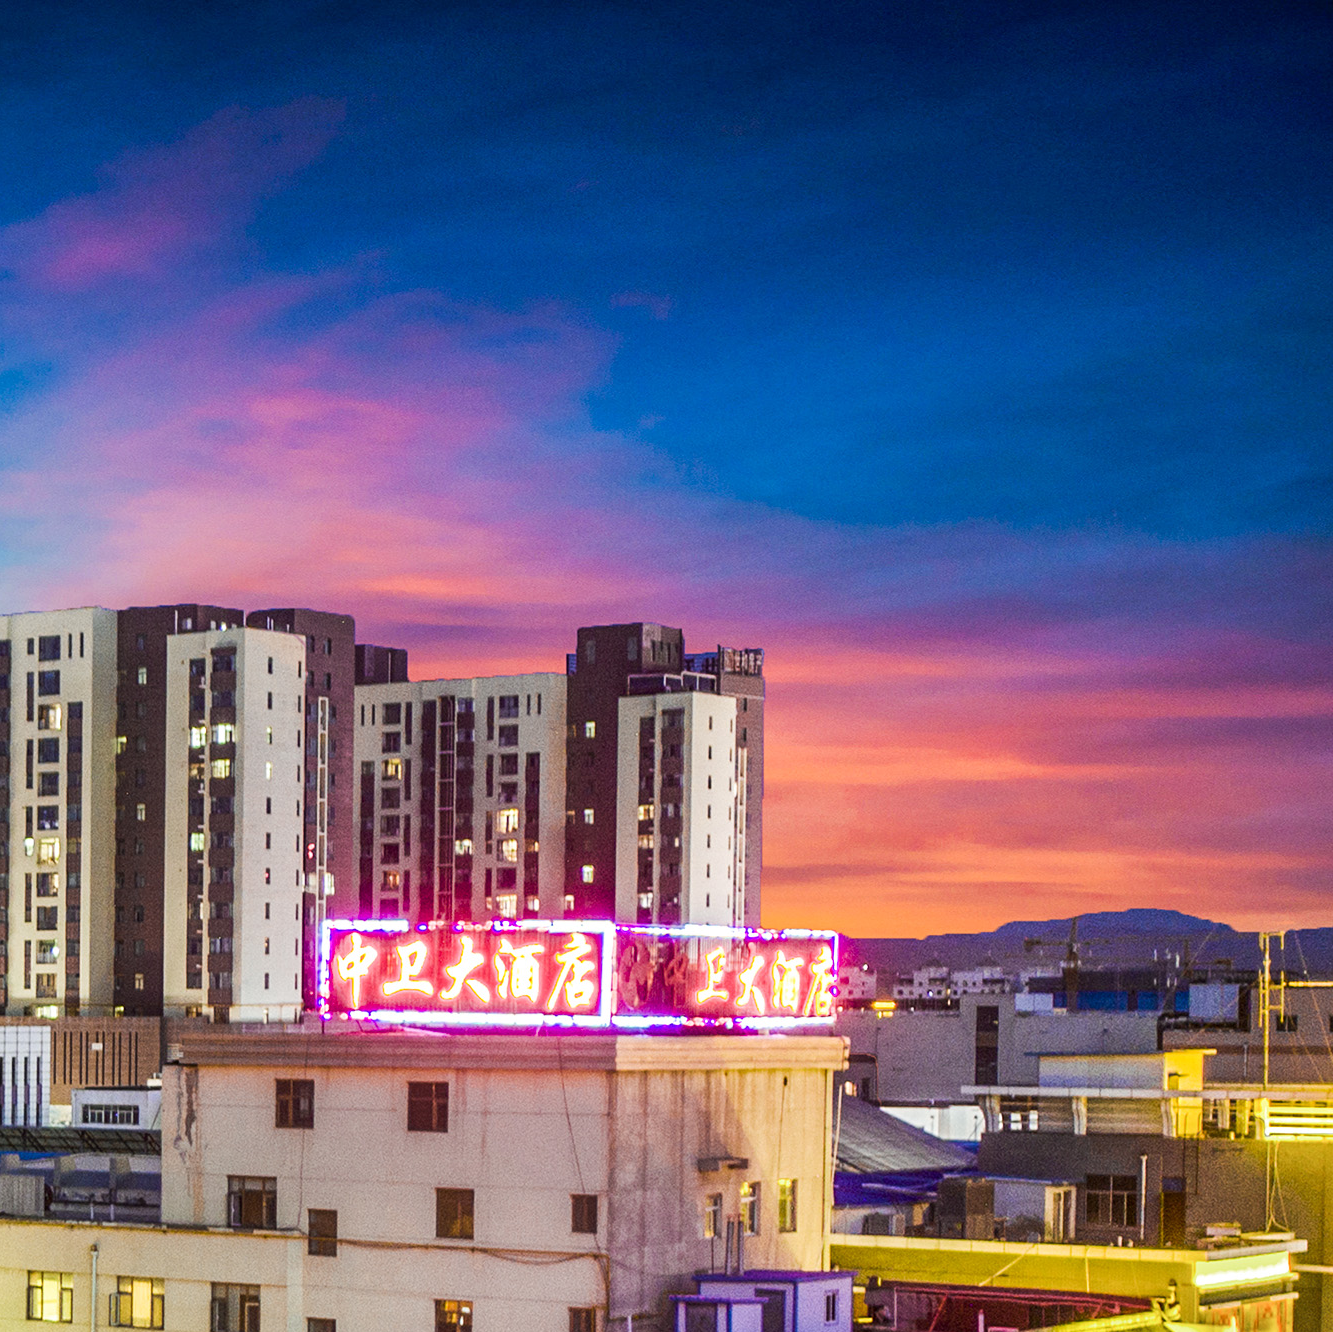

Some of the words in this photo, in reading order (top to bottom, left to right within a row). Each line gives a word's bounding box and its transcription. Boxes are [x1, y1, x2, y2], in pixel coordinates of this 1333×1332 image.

[337, 932, 596, 1010] 中卫大酒店
